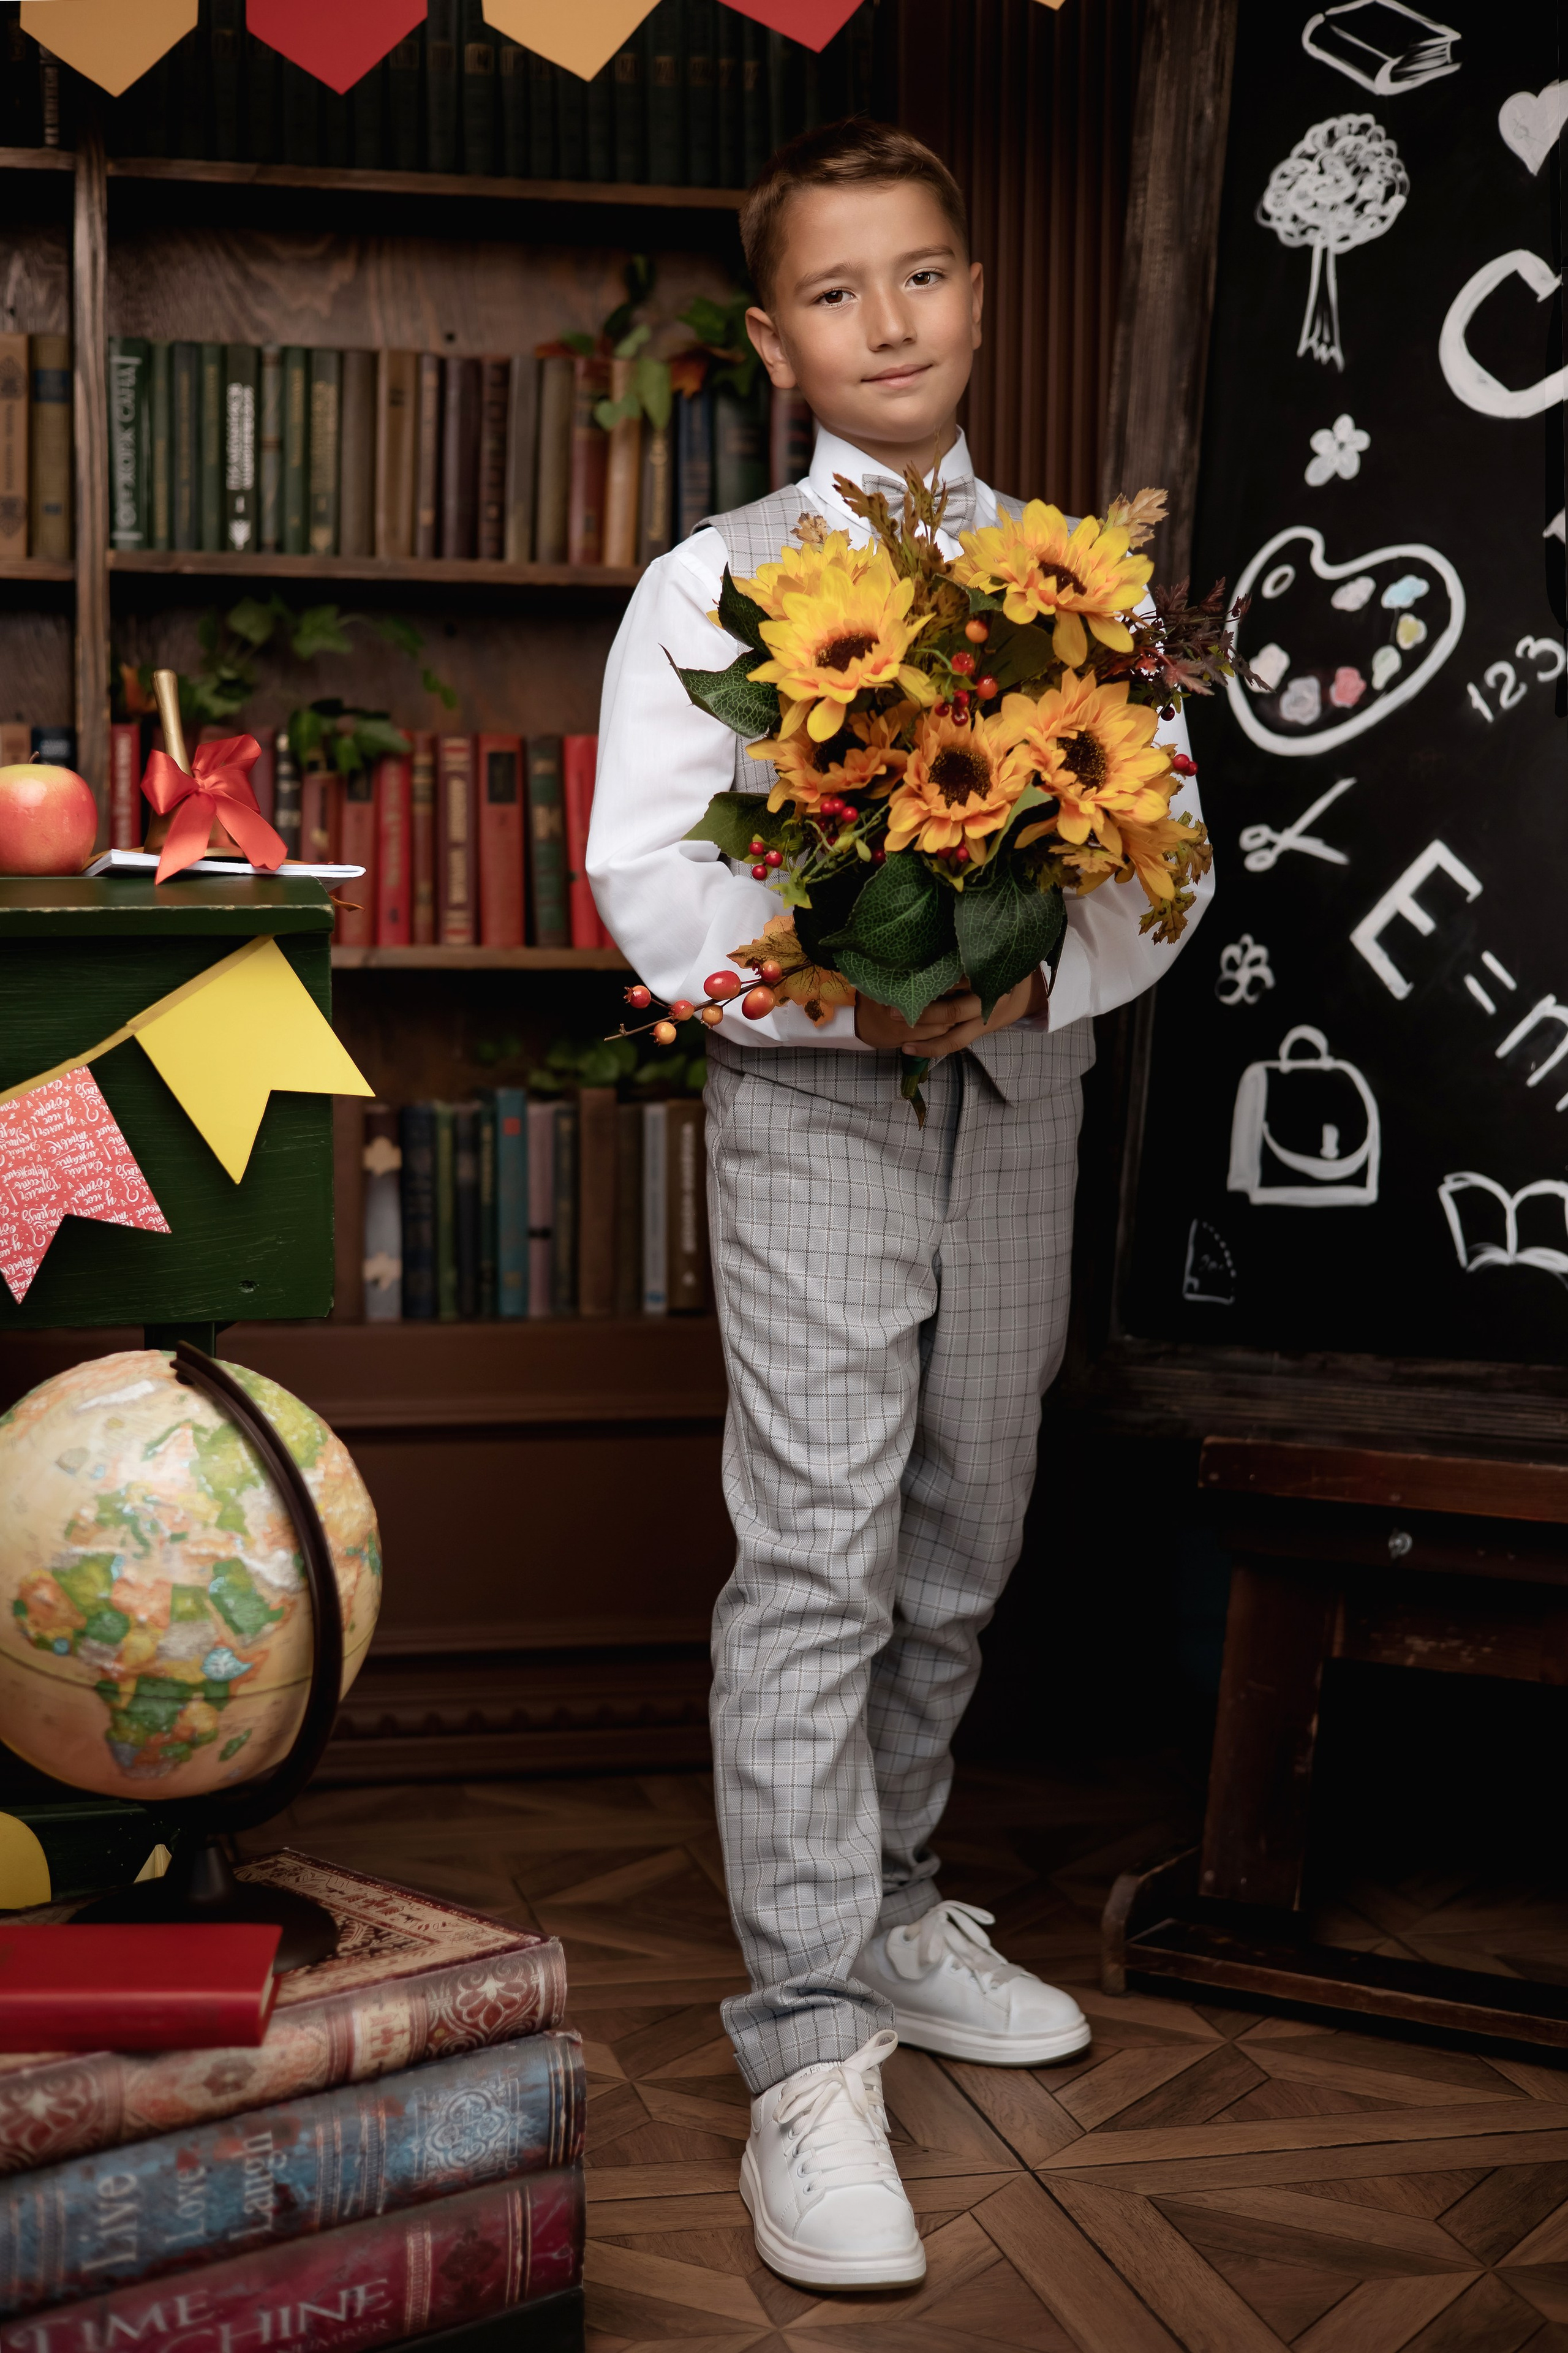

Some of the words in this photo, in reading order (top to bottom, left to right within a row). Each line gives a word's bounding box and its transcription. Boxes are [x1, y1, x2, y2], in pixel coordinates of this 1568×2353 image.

[1467, 635, 1566, 723] 123
[43, 1112, 61, 1124] нос
[6, 1139, 40, 1160] Давай
[75, 1139, 94, 1150] на
[65, 1158, 103, 1179] Давай
[83, 1193, 102, 1206] нос
[228, 2130, 288, 2241] Laugh
[165, 2164, 206, 2245] Love
